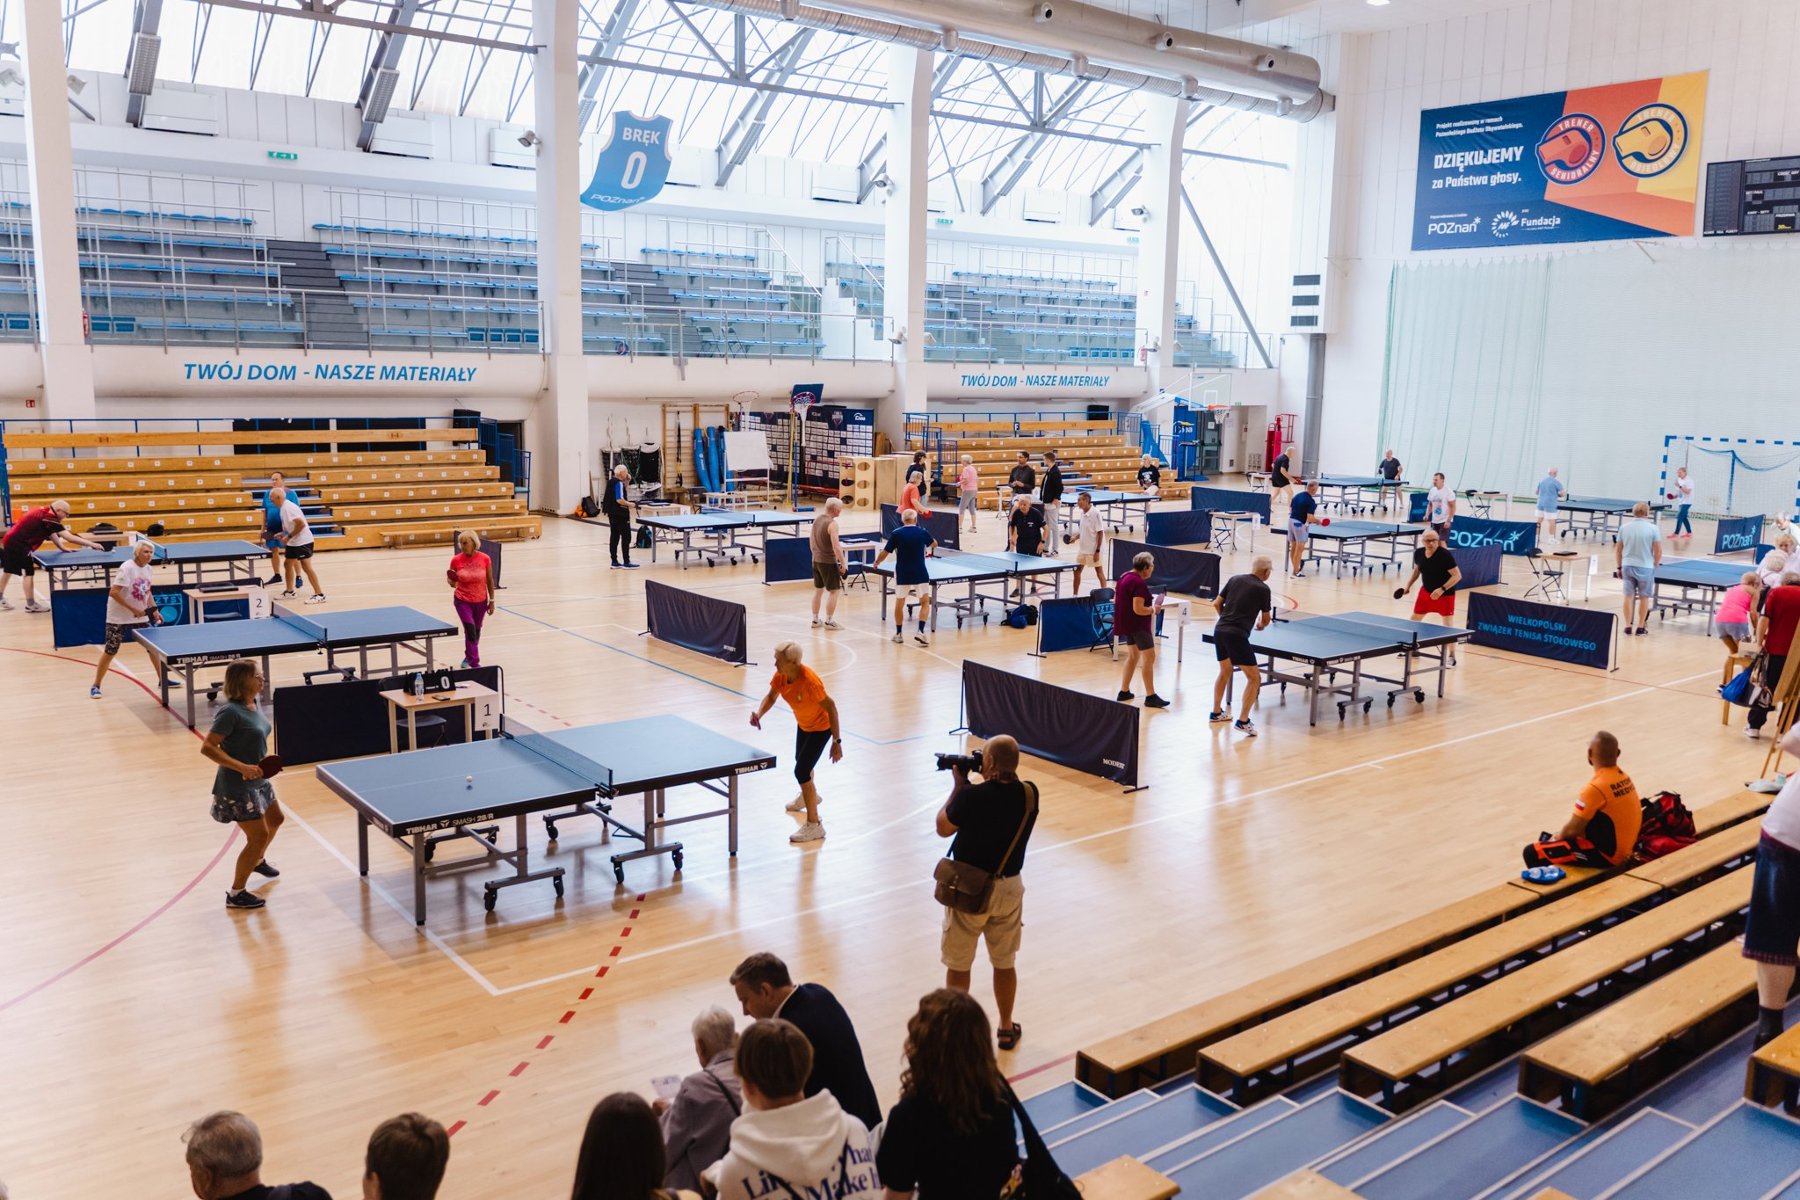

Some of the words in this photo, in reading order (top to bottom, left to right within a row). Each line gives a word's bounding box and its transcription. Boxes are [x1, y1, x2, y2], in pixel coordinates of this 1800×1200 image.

[1434, 145, 1524, 173] DZIĘKUJEMY
[621, 151, 647, 189] 0
[1432, 178, 1443, 189] za
[1445, 174, 1488, 188] Państwa
[1490, 172, 1521, 186] głosy.
[1521, 216, 1561, 227] Fundacja
[184, 360, 243, 380] TWÓJ
[247, 365, 297, 381] DOM
[314, 364, 376, 380] NASZE
[379, 365, 477, 382] MATERIAŁY
[961, 373, 991, 387] TWÓJ
[992, 375, 1017, 387] DOM
[1025, 375, 1056, 386] NASZE
[1058, 375, 1110, 387] MATERIAŁY
[256, 598, 263, 608] 2
[1182, 607, 1187, 616] 4
[1507, 614, 1567, 632] WIELKOPOLSKI
[1478, 622, 1512, 635] ZWIĄZEK
[1514, 627, 1542, 641] TENISA
[1543, 634, 1597, 651] STOŁOWEGO
[176, 655, 208, 664] TIBHAR
[441, 676, 450, 689] 0
[484, 704, 491, 716] 1
[406, 823, 438, 834] TIBHAR
[452, 817, 476, 825] SMASH
